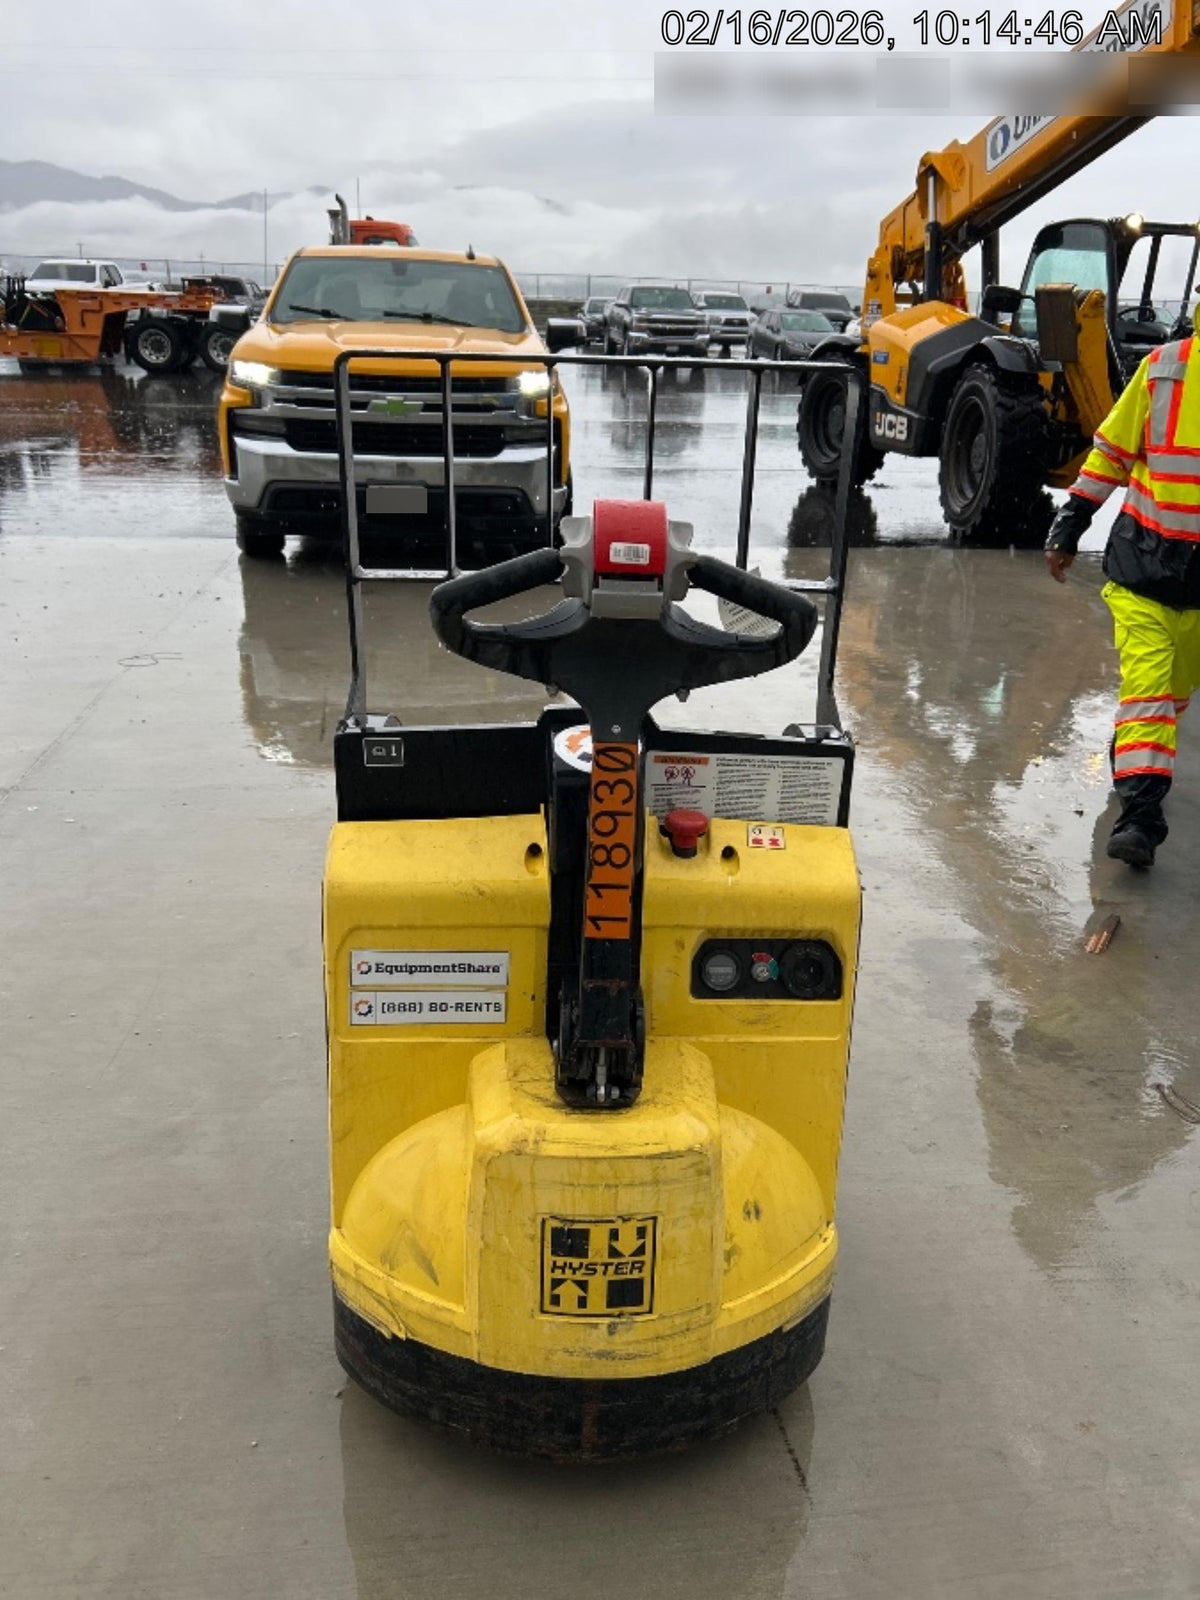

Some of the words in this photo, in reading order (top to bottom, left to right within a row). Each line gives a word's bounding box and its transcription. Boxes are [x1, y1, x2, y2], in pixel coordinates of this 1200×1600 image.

[875, 412, 908, 440] JCB
[587, 745, 637, 932] 118930
[374, 962, 501, 976] EquipmentShare
[550, 1260, 646, 1276] HYSTER
